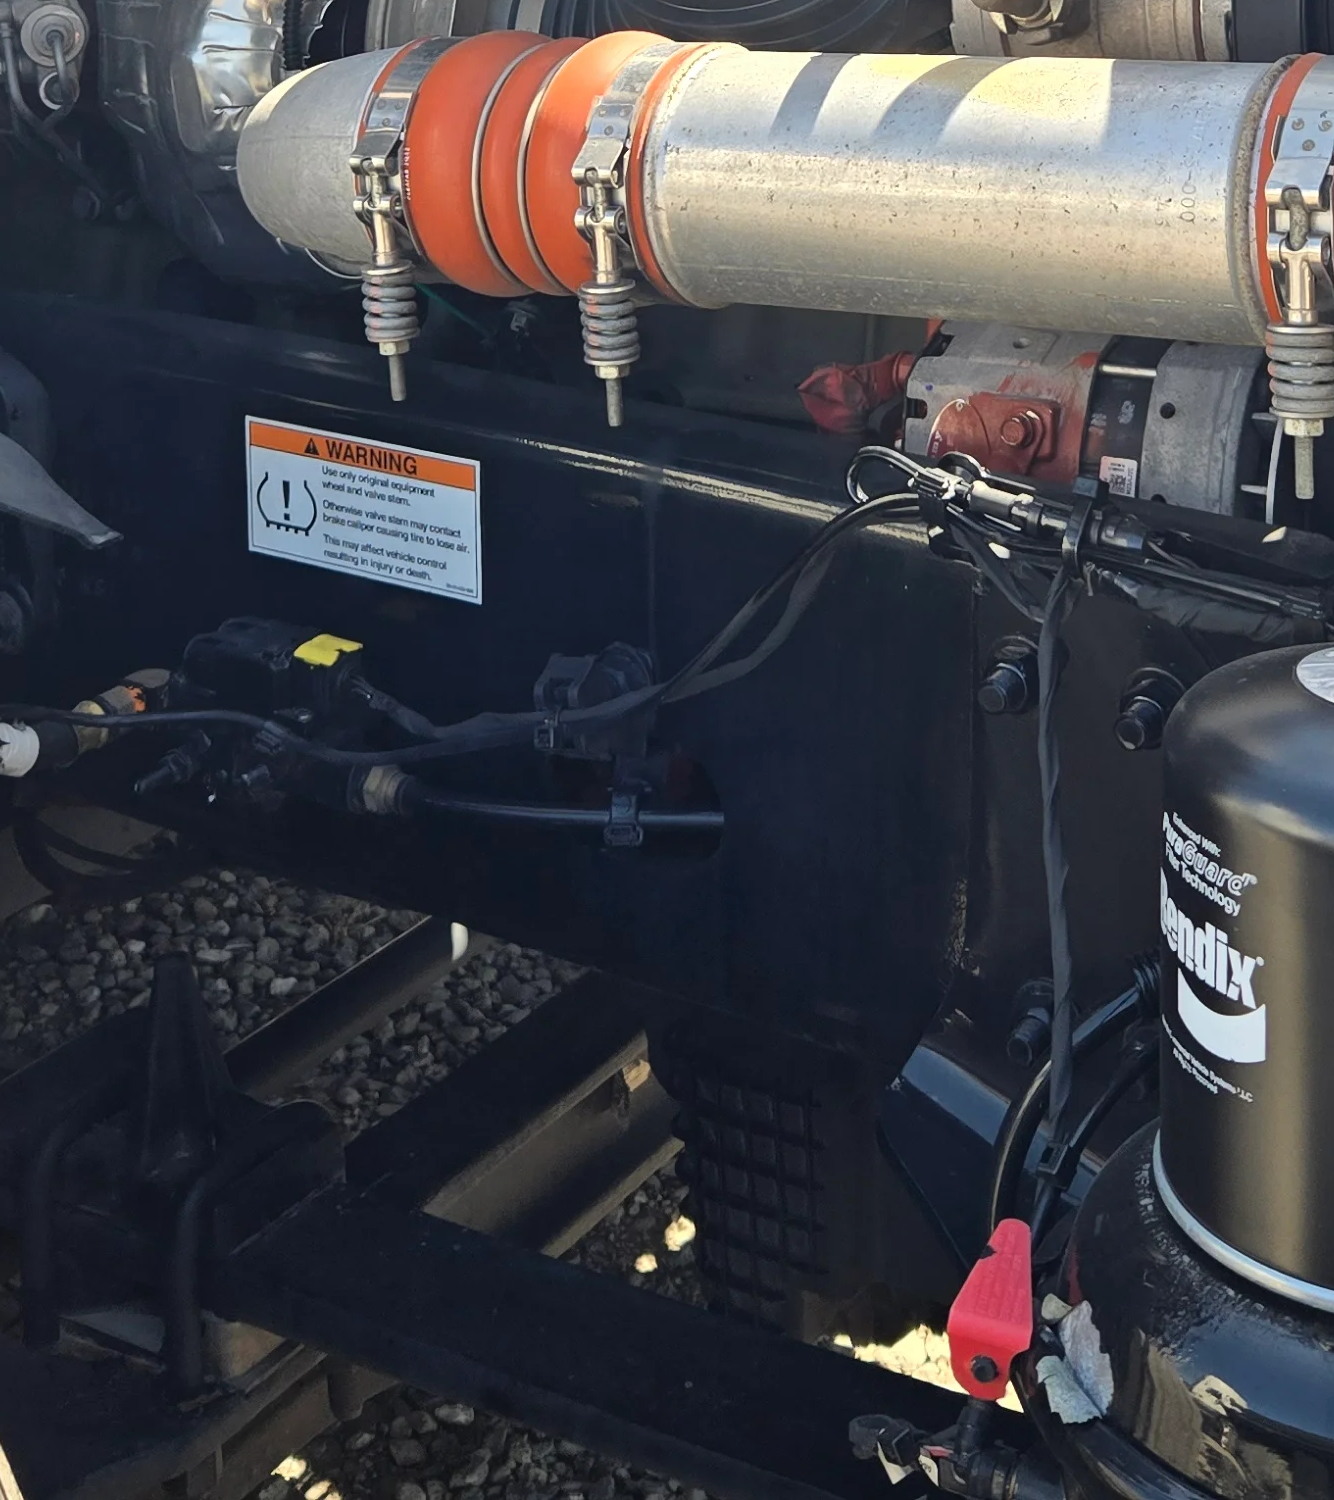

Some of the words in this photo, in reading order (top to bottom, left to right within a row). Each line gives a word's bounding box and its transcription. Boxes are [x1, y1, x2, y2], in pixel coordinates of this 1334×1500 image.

[325, 439, 417, 475] WARNING
[322, 466, 338, 477] Use
[339, 469, 357, 483] only
[358, 473, 389, 489] original
[391, 481, 435, 498] equipment
[322, 480, 345, 492] wheel
[347, 484, 362, 496] and
[364, 487, 386, 501] valve
[387, 494, 411, 506] stem.
[322, 499, 363, 516] Otherwise
[365, 509, 387, 522] valve
[388, 514, 408, 526] stem
[410, 520, 428, 533] may
[429, 523, 462, 538] contact
[323, 513, 346, 526] brake
[347, 520, 375, 533] caliper
[376, 526, 409, 542] causing
[410, 532, 425, 544] tire
[426, 536, 435, 545] to
[436, 538, 455, 549] lose
[456, 542, 470, 554] air.
[323, 533, 340, 546] This
[342, 540, 360, 552] may
[361, 544, 385, 557] affect
[386, 549, 416, 563] vehicle
[417, 556, 447, 570] control
[324, 549, 359, 565] resulting
[361, 557, 368, 566] in
[370, 559, 394, 574] injury
[395, 565, 405, 574] or
[406, 567, 432, 581] death.
[1180, 860, 1241, 917] Technology
